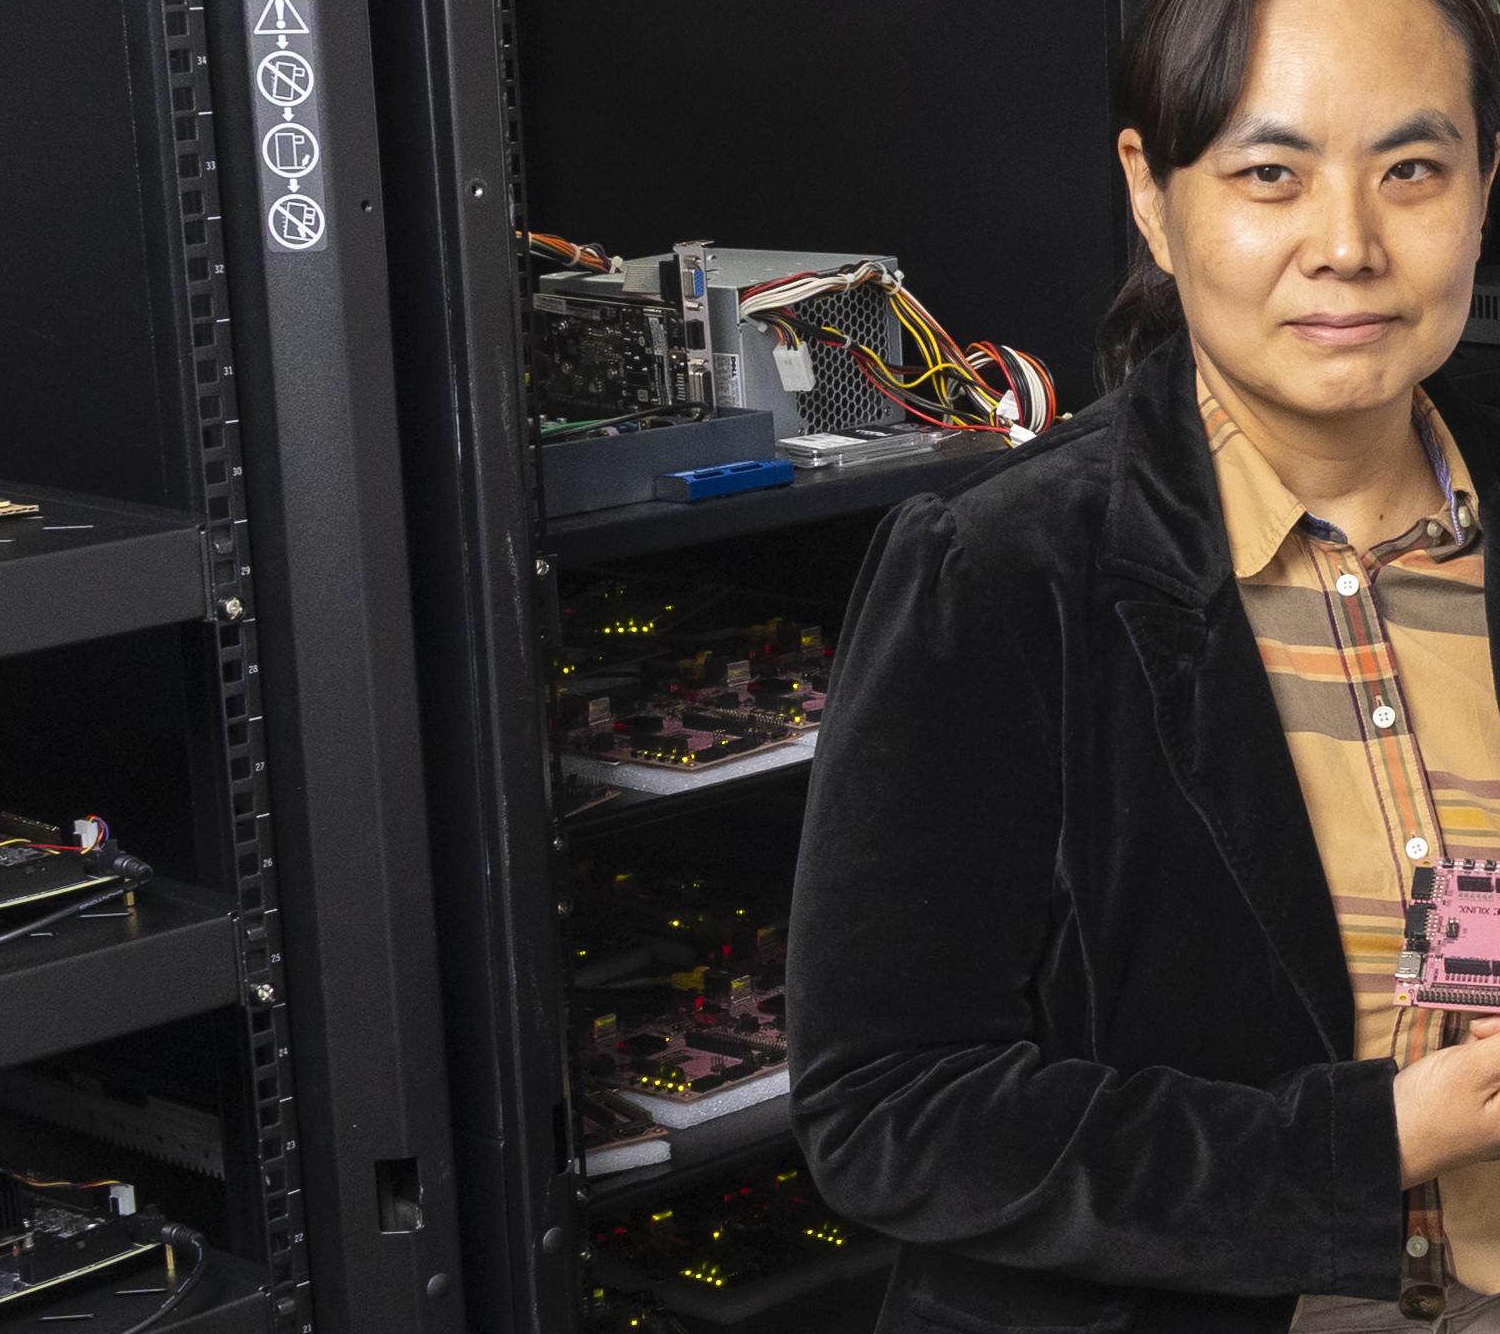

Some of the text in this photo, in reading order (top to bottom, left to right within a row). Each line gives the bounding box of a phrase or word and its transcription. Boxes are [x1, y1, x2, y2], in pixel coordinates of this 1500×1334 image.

[197, 55, 206, 65] 34
[205, 160, 215, 170] 33
[214, 264, 224, 273] 32
[223, 365, 232, 375] 31
[232, 466, 242, 476] 30
[240, 565, 250, 575] 29
[248, 664, 258, 673] 28
[255, 761, 264, 771] 27
[262, 857, 272, 867] 26
[1459, 906, 1491, 915] XILINX
[270, 952, 280, 962] 25
